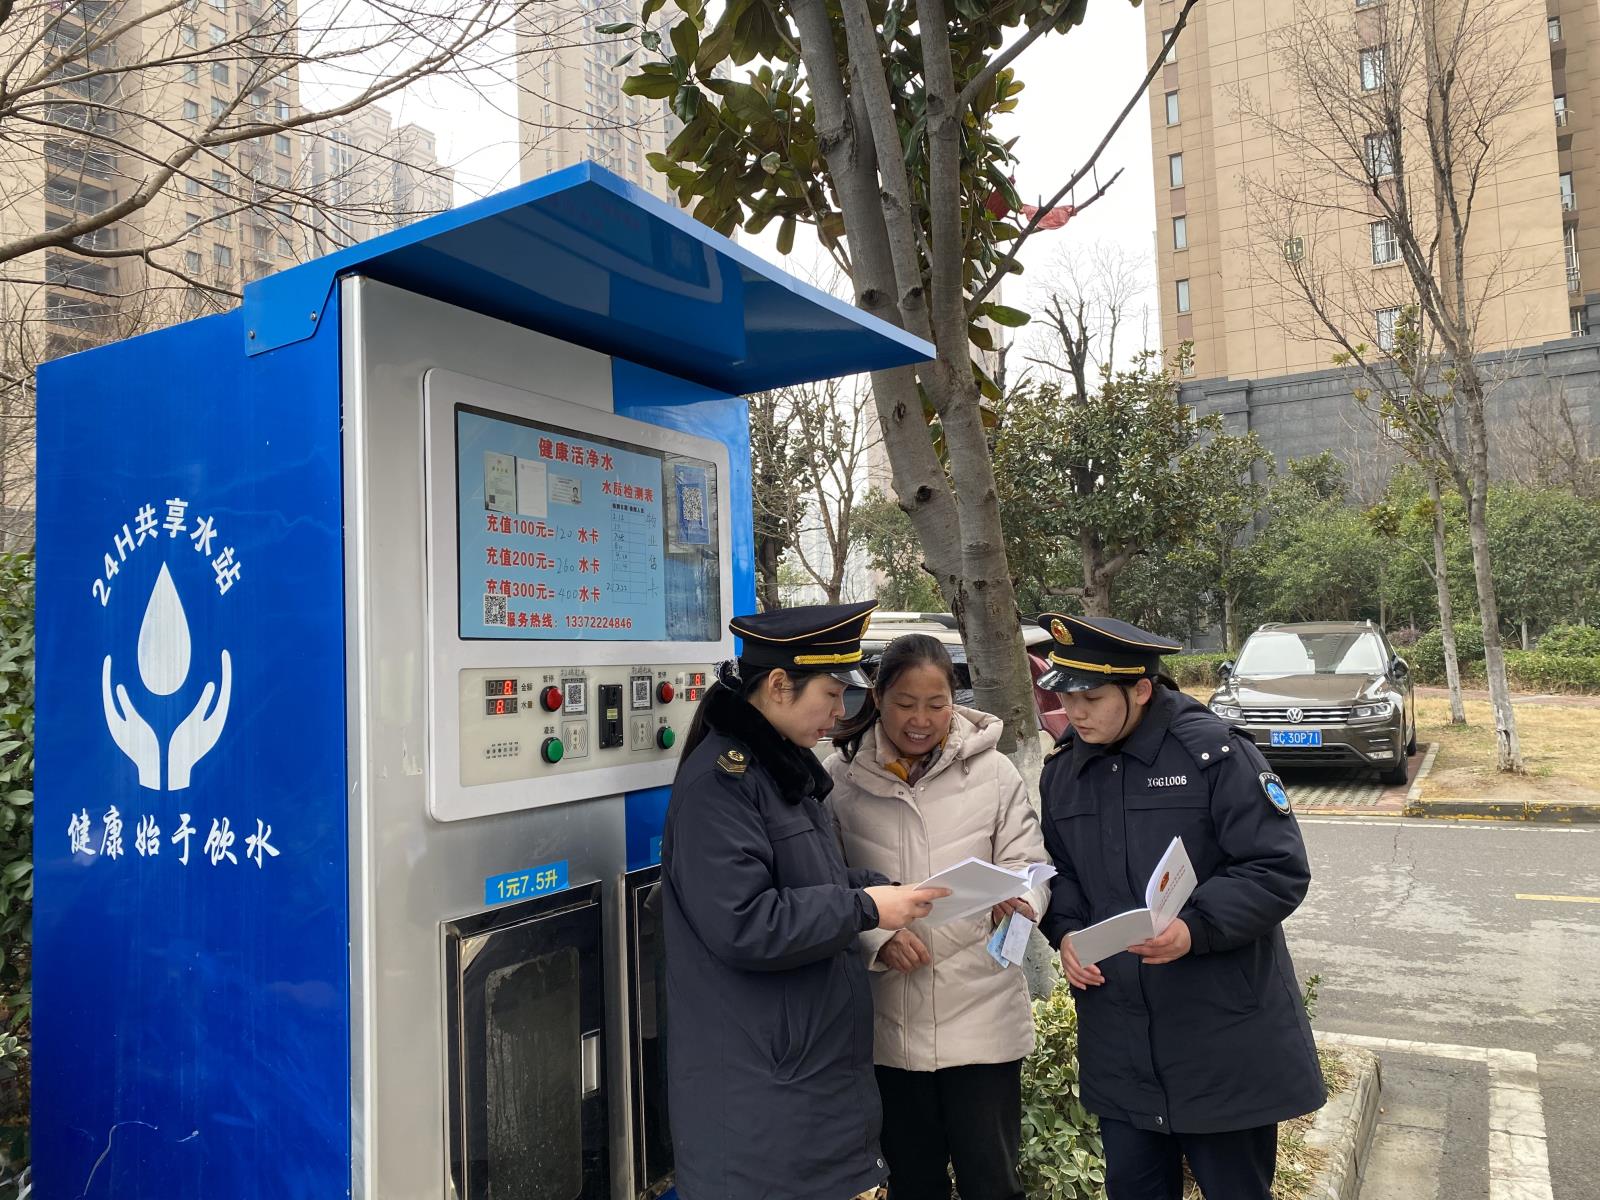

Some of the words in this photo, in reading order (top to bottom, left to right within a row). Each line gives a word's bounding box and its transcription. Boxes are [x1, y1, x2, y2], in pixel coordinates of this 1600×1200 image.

[539, 437, 613, 471] 健康活净水
[602, 480, 653, 503] 水质检测表
[486, 513, 554, 539] 充值100元=
[578, 527, 599, 544] 水卡
[93, 498, 241, 607] 24H共享水站
[486, 546, 555, 570] 充值200元=
[579, 556, 600, 574] 水卡
[579, 585, 601, 602] 水卡
[565, 615, 632, 629] 13372224846
[67, 805, 280, 869] 健康始于饮水
[497, 868, 558, 899] 1元7.5升
